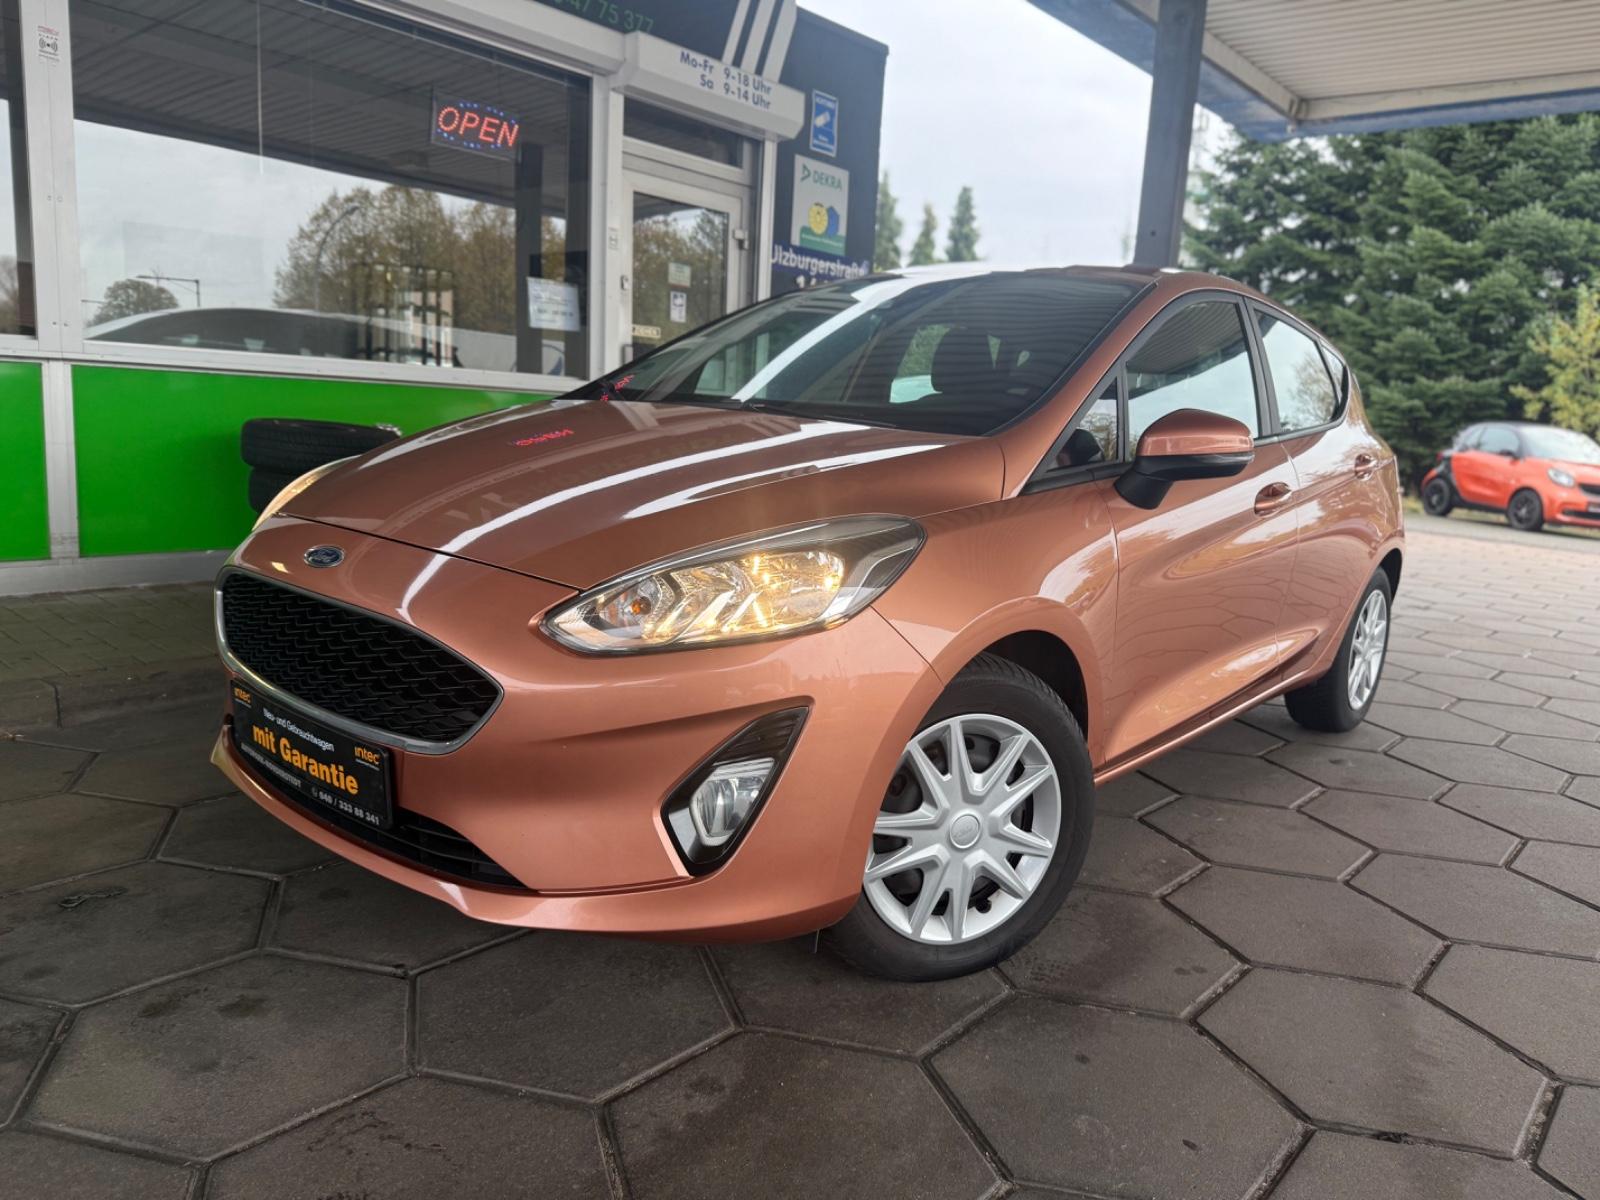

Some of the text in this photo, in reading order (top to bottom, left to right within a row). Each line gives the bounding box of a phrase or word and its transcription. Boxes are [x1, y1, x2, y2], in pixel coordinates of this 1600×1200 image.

[599, 0, 619, 24] 75
[623, 9, 654, 33] 377
[680, 51, 772, 95] Mo-Fr 9-18 Uhr
[700, 73, 771, 109] Sa 9-14 Uhr
[438, 106, 519, 147] OPEN
[812, 170, 843, 191] DEKRA
[253, 724, 276, 754] mit
[280, 737, 359, 795] Garantie
[355, 746, 380, 765] intec
